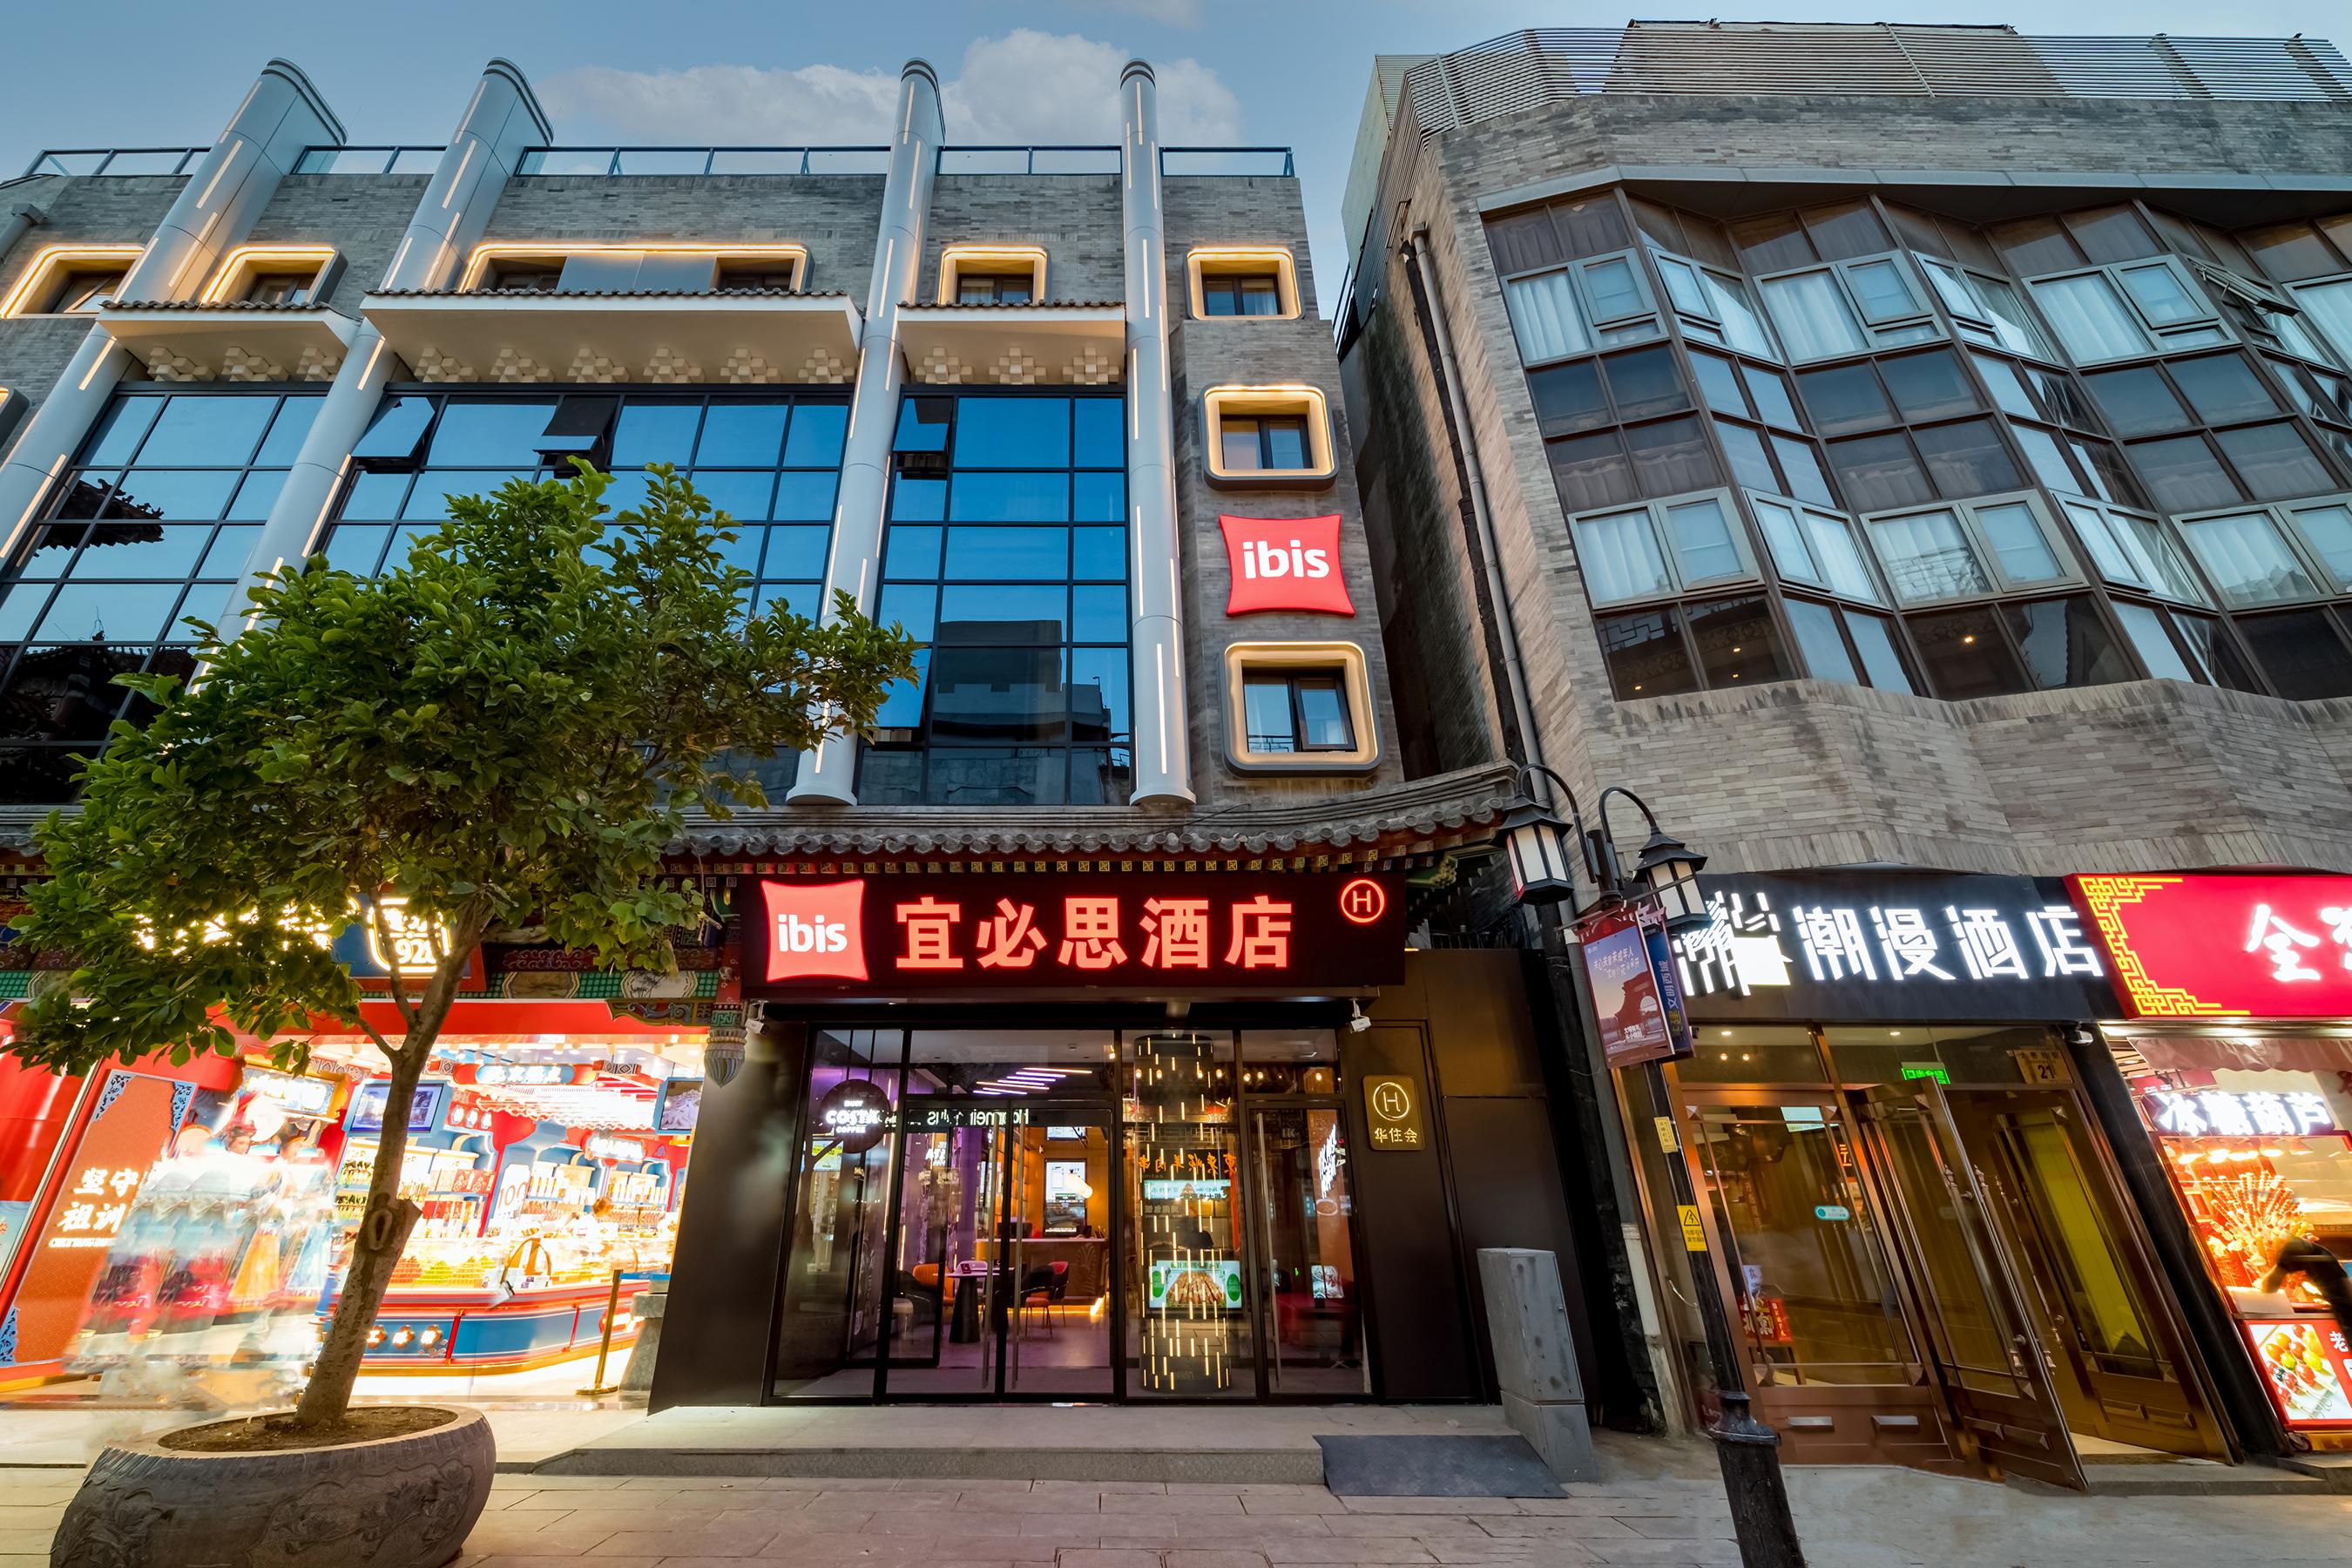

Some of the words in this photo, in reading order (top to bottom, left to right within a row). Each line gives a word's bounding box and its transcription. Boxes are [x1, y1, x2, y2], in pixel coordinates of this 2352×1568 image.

[1243, 539, 1330, 579] ibis
[777, 914, 848, 953] ibis
[896, 896, 1292, 969] 宜必思酒店
[1792, 904, 2104, 981] 潮漫酒店
[2038, 1056, 2056, 1079] 21
[1374, 1127, 1417, 1144] 华住会
[73, 1167, 139, 1198] 坚守
[57, 1201, 127, 1233] 祖训
